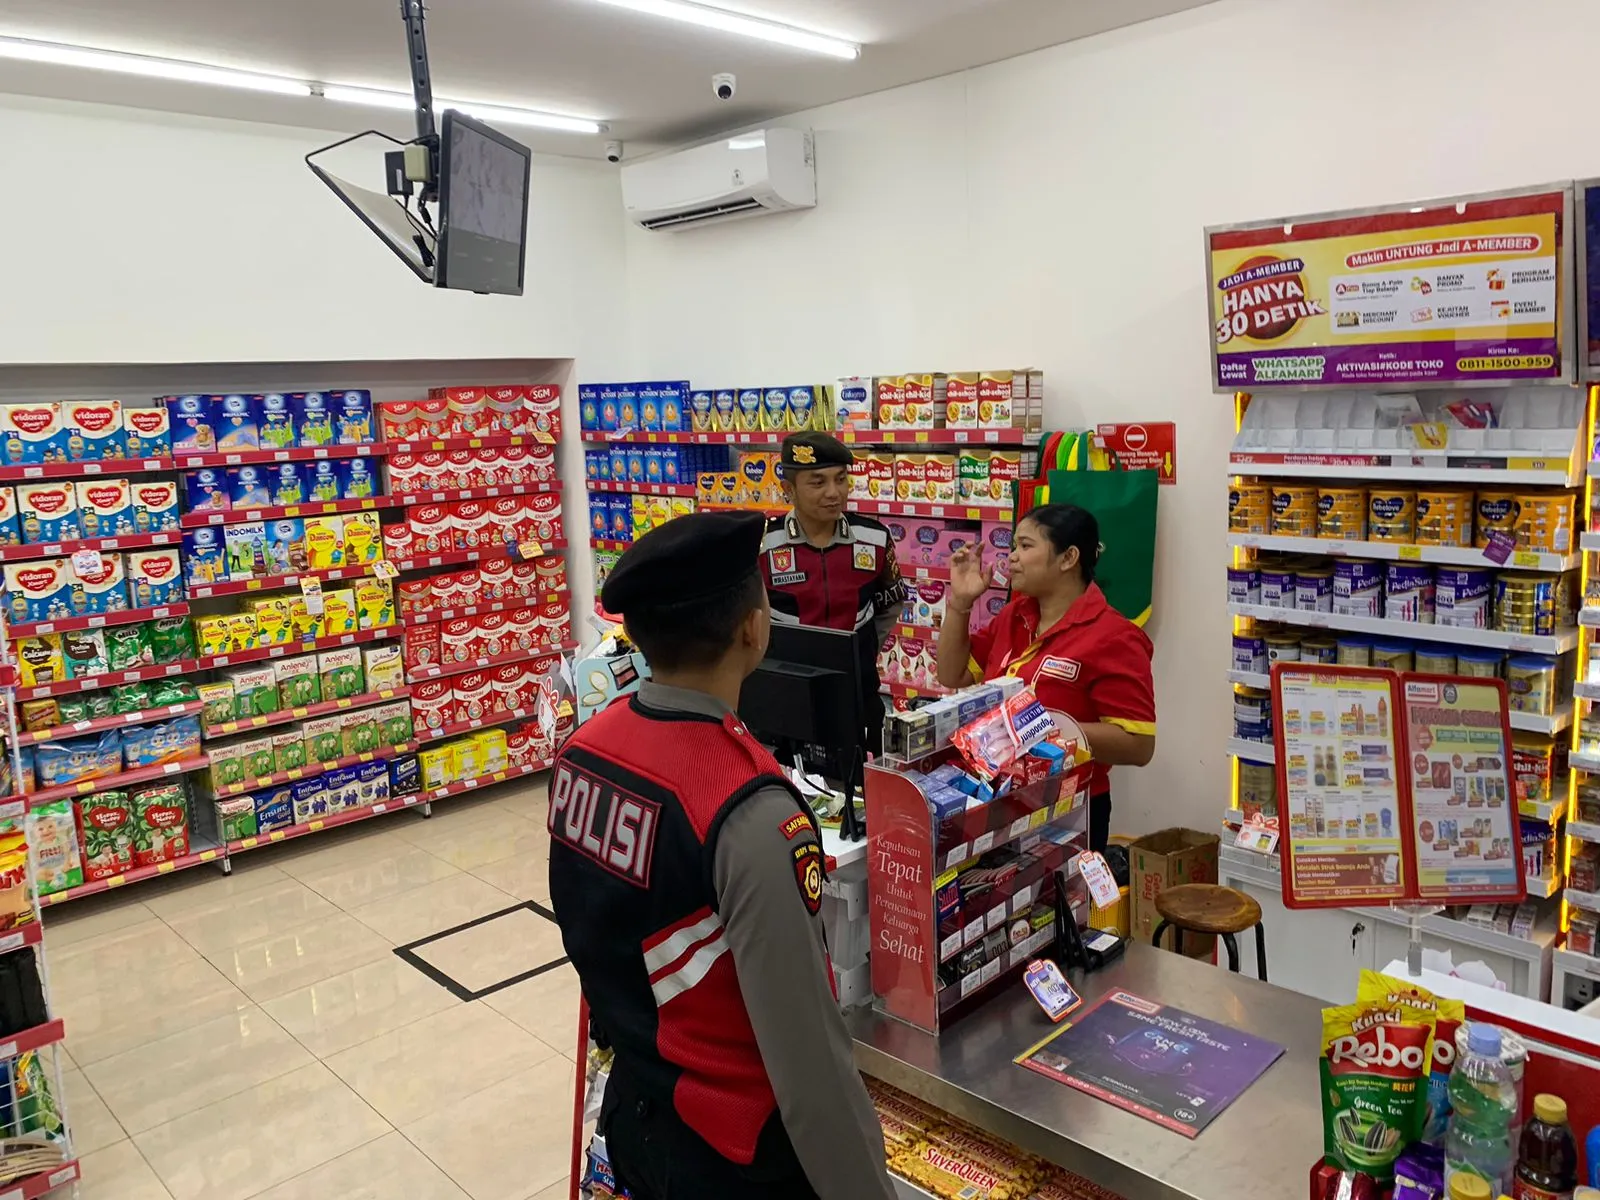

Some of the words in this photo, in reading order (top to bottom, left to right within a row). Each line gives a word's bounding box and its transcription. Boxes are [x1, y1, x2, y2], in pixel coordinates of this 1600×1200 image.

[1352, 254, 1383, 267] Makin
[1385, 244, 1433, 261] UNTUNG
[1436, 243, 1460, 255] Jadi
[1463, 238, 1532, 251] A-MEMBER
[1223, 274, 1244, 289] JADI
[1246, 260, 1300, 281] A-MEMBER
[1512, 270, 1549, 278] PROGRAM
[1223, 281, 1304, 315] HANYA
[1514, 301, 1536, 309] EVENT
[1438, 312, 1470, 320] VOUCHER
[1514, 307, 1546, 315] MEMBER
[1216, 312, 1248, 343] 30
[1254, 299, 1327, 329] DETIK
[1220, 363, 1247, 372] Daftar
[1253, 358, 1324, 370] WHATSAPP
[1416, 360, 1443, 370] TOKO
[1459, 356, 1551, 370] 0811-1500-959
[1221, 371, 1247, 379] Lewat
[1256, 368, 1323, 380] ALFAMART
[459, 391, 475, 401] SGM
[497, 389, 513, 399] SGM
[533, 388, 551, 400] SGM
[906, 390, 931, 400] chil-kid
[393, 403, 407, 412] SGM
[426, 402, 440, 410] SGM
[12, 413, 50, 422] vidoran
[75, 412, 111, 421] vidoran
[132, 416, 160, 424] vidoran
[480, 448, 496, 458] SGM
[507, 447, 522, 456] SGM
[533, 445, 547, 454] SGM
[395, 455, 412, 465] SGM
[424, 452, 440, 462] SGM
[452, 450, 468, 460] SGM
[927, 468, 953, 478] chil-kid
[961, 464, 989, 474] chil-kid
[88, 491, 119, 500] vidoran
[140, 491, 168, 499] vidoran
[30, 496, 64, 505] vidoran
[497, 499, 516, 511] SGM
[535, 494, 552, 507] SGM
[421, 508, 439, 520] SGM
[460, 504, 479, 515] SGM
[226, 526, 263, 537] INDOMILK
[347, 529, 371, 539] Dancow
[391, 527, 406, 536] SGM
[310, 533, 334, 543] Dancow
[142, 561, 171, 570] vidoran
[488, 559, 505, 570] SGM
[544, 559, 556, 567] SGM
[517, 566, 530, 575] SGM
[18, 572, 53, 582] vidoran
[437, 575, 451, 585] SGM
[462, 574, 476, 583] SGM
[1392, 576, 1433, 591] PediaSure
[361, 593, 384, 602] Dancow
[327, 604, 347, 613] Dancow
[547, 605, 562, 616] SGM
[260, 614, 282, 623] Dancow
[515, 610, 531, 621] SGM
[450, 621, 468, 632] SGM
[484, 616, 501, 627] SGM
[324, 654, 349, 664] Anlene
[280, 661, 306, 672] Anlene
[536, 659, 553, 671] SGM
[501, 666, 519, 679] SGM
[239, 673, 264, 684] Anlene
[463, 675, 482, 688] SGM
[421, 683, 442, 697] SGM
[1408, 684, 1436, 694] Alfamart
[379, 706, 404, 715] Anlene
[344, 714, 369, 724] Anlene
[308, 721, 331, 731] Anlene
[1020, 717, 1056, 745] Pepsodent
[511, 737, 525, 746] SGM
[361, 765, 387, 777] Entrasol
[329, 772, 355, 784] Entrasol
[298, 783, 322, 795] Entrasol
[260, 804, 288, 821] Ensure
[549, 766, 653, 878] POLISI
[876, 834, 922, 859] Keputusan
[876, 850, 922, 884] Tepat
[886, 882, 914, 902] Untuk
[882, 911, 920, 936] Keluarga
[879, 928, 925, 964] Sehat
[1155, 1015, 1182, 1028] NEW
[1351, 1008, 1401, 1033] Kuaci
[1128, 1010, 1156, 1025] SAME
[1158, 1021, 1195, 1039] FRESH
[1196, 1034, 1231, 1051] TASTE
[1144, 1031, 1190, 1056] CAMEL
[1330, 1026, 1423, 1070] Rebo
[1354, 1096, 1383, 1113] Green
[1387, 1105, 1403, 1116] Tea
[1177, 1110, 1194, 1120] 18+
[948, 1130, 1018, 1169] SILVERQUEEN
[923, 1147, 998, 1191] SILVERQUEEN
